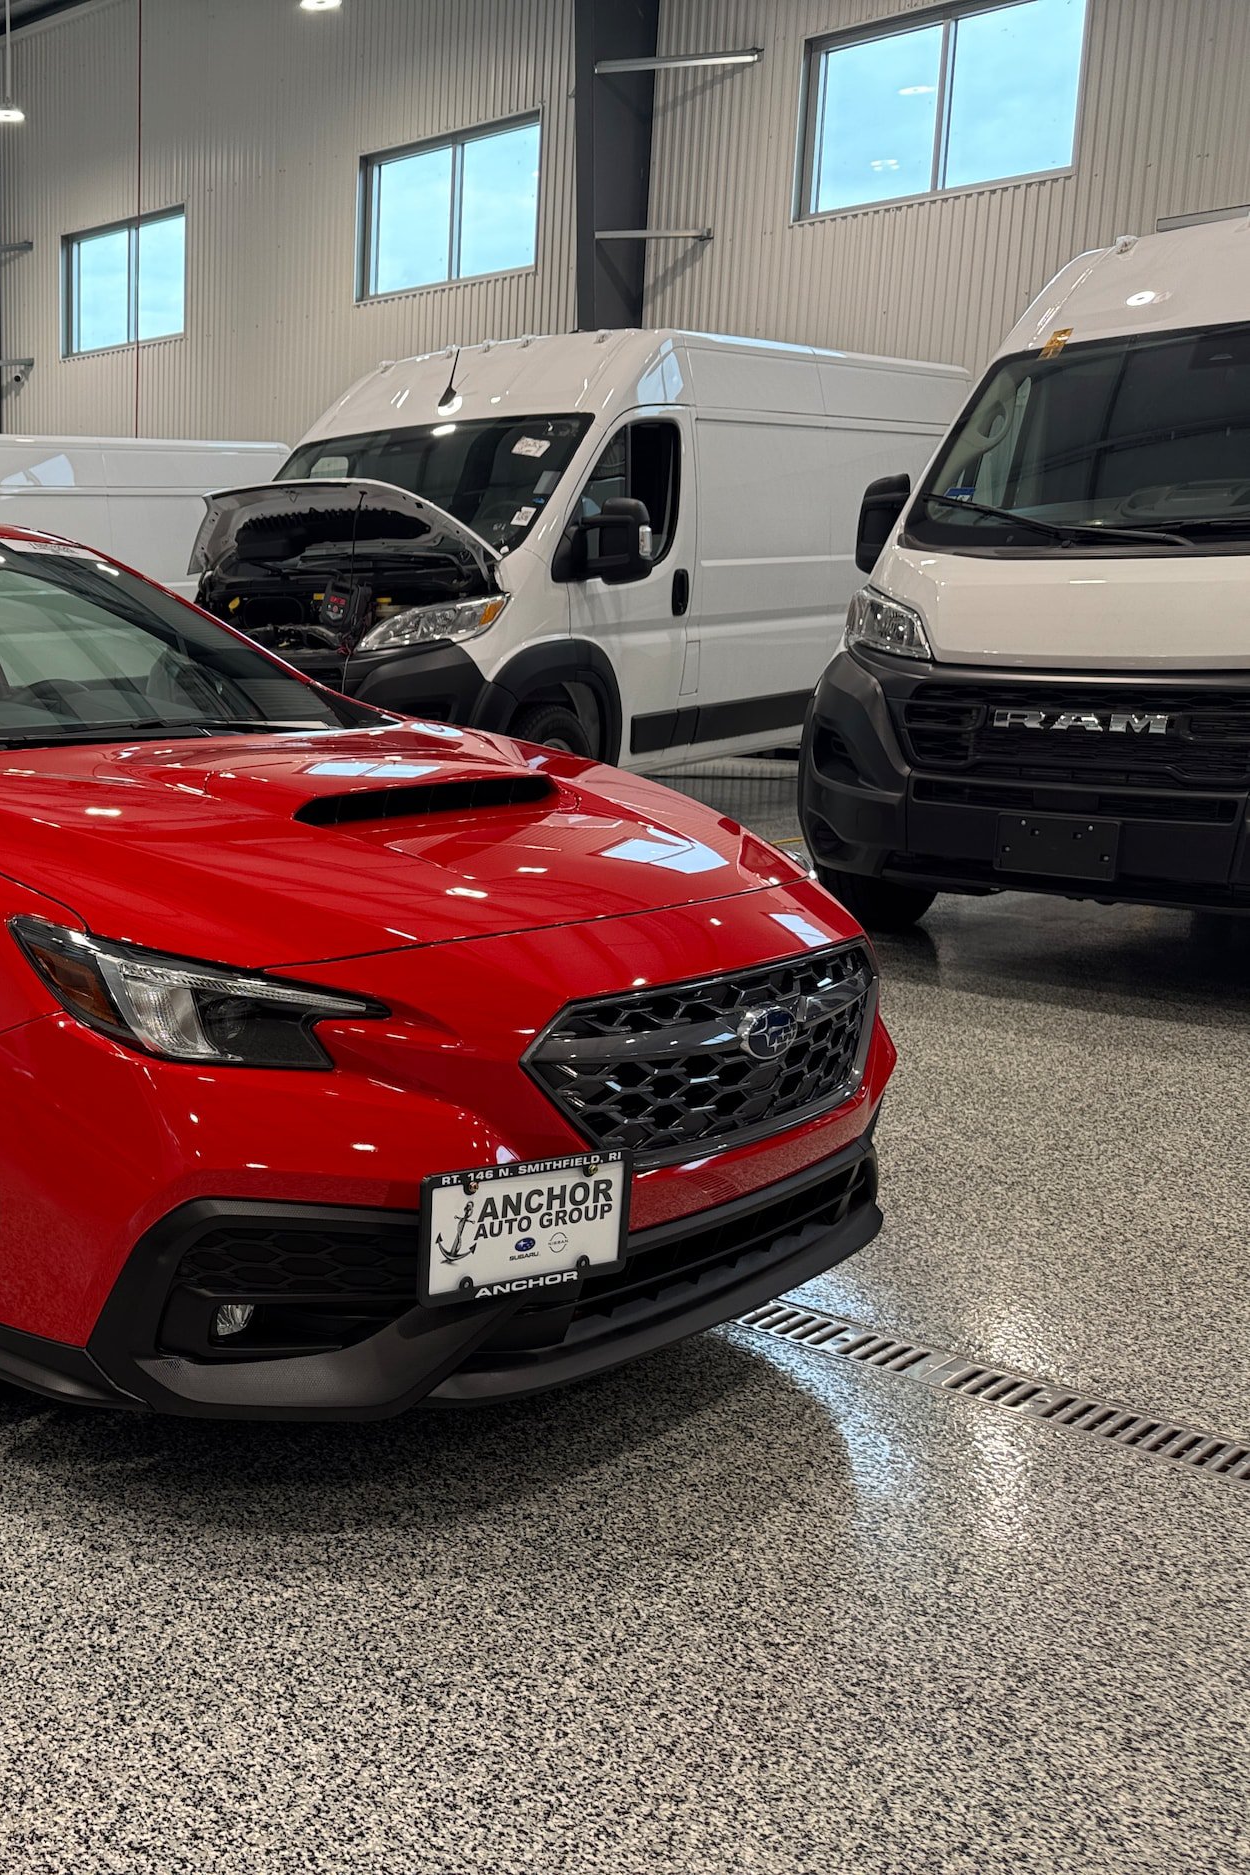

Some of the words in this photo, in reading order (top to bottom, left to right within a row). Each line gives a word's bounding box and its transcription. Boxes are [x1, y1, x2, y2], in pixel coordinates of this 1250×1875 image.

[993, 709, 1168, 735] RAM
[441, 1174, 462, 1186] RT.
[468, 1170, 494, 1182] 146
[499, 1168, 514, 1177] N.
[608, 1151, 622, 1162] RI
[477, 1179, 613, 1222] ANCHOR
[474, 1215, 532, 1241] AUTO
[539, 1203, 613, 1229] GROUP
[509, 1251, 540, 1261] SUBARU
[474, 1270, 579, 1299] ANCHOR
